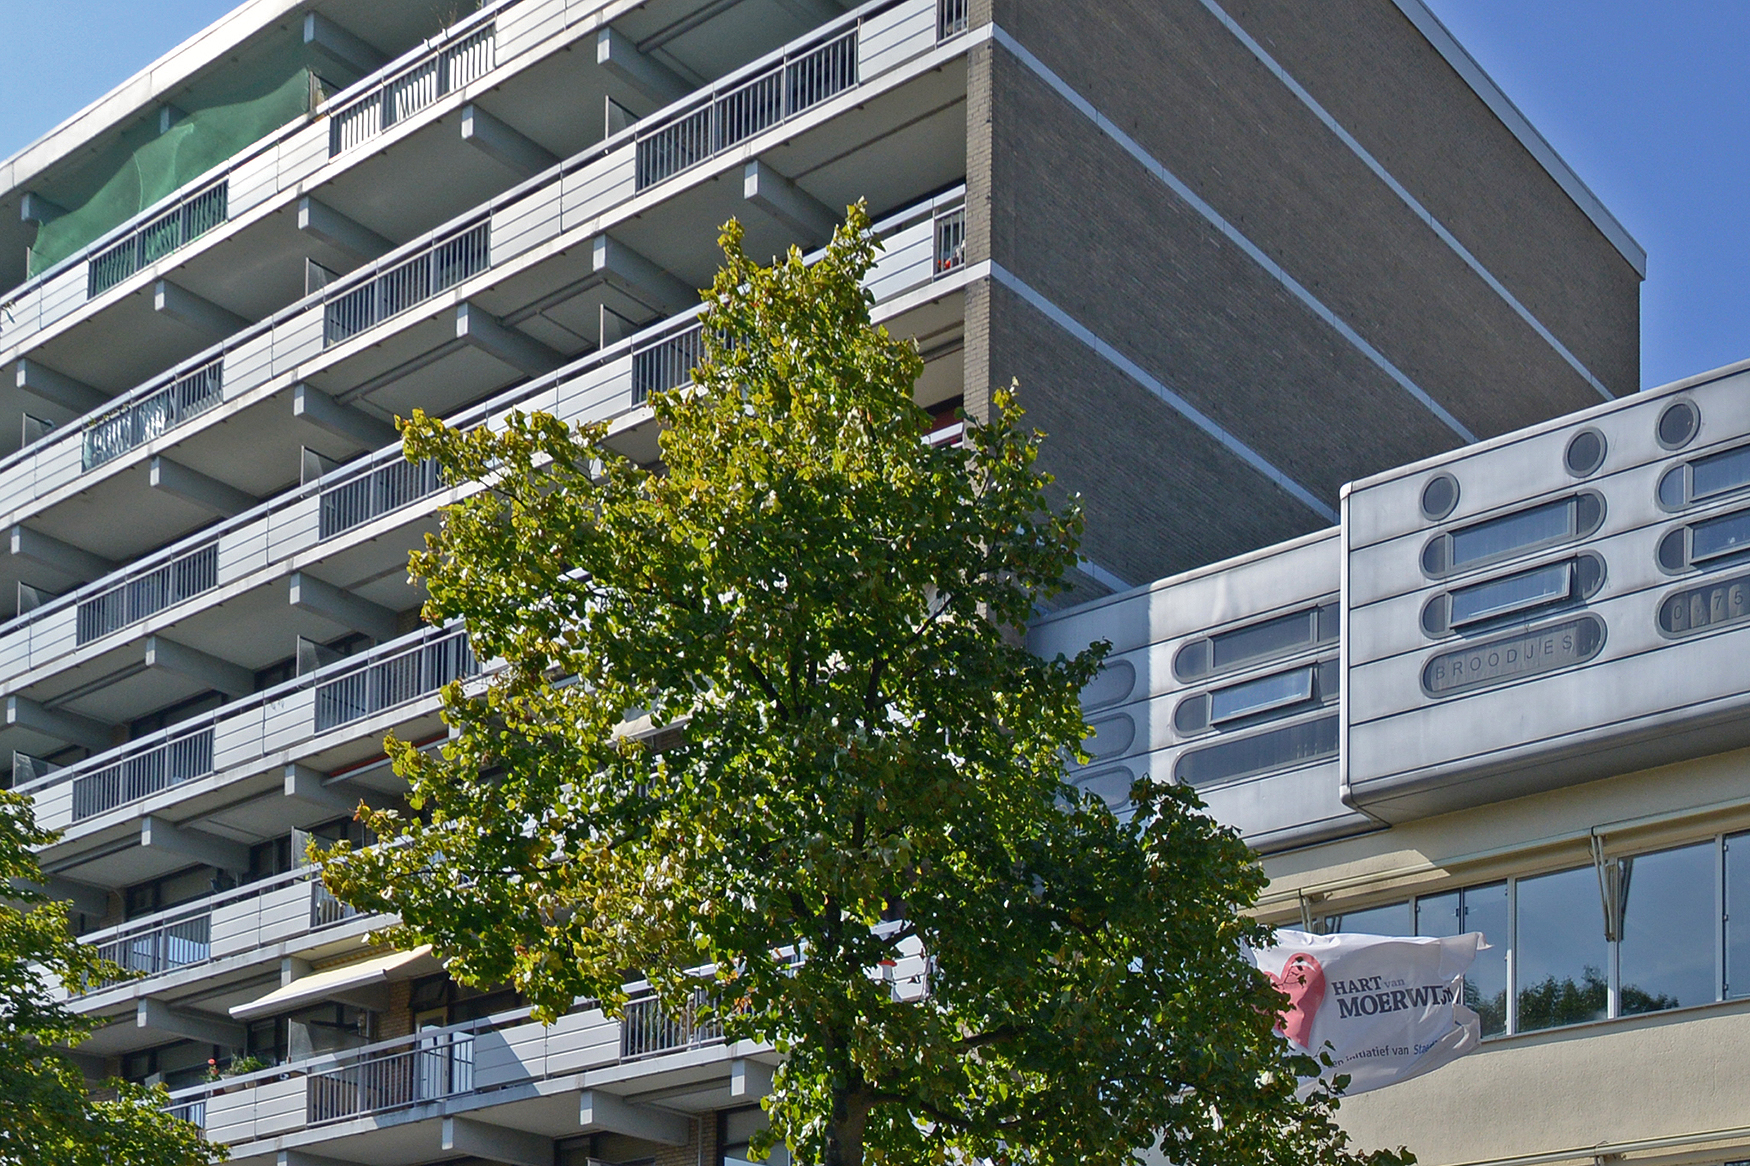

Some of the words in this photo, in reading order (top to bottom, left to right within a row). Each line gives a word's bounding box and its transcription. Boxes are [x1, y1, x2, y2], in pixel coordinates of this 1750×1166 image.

[1435, 635, 1573, 680] BROODJES
[1331, 976, 1382, 995] HART
[1384, 979, 1405, 989] van
[1328, 1058, 1344, 1069] en
[1391, 1046, 1409, 1056] van
